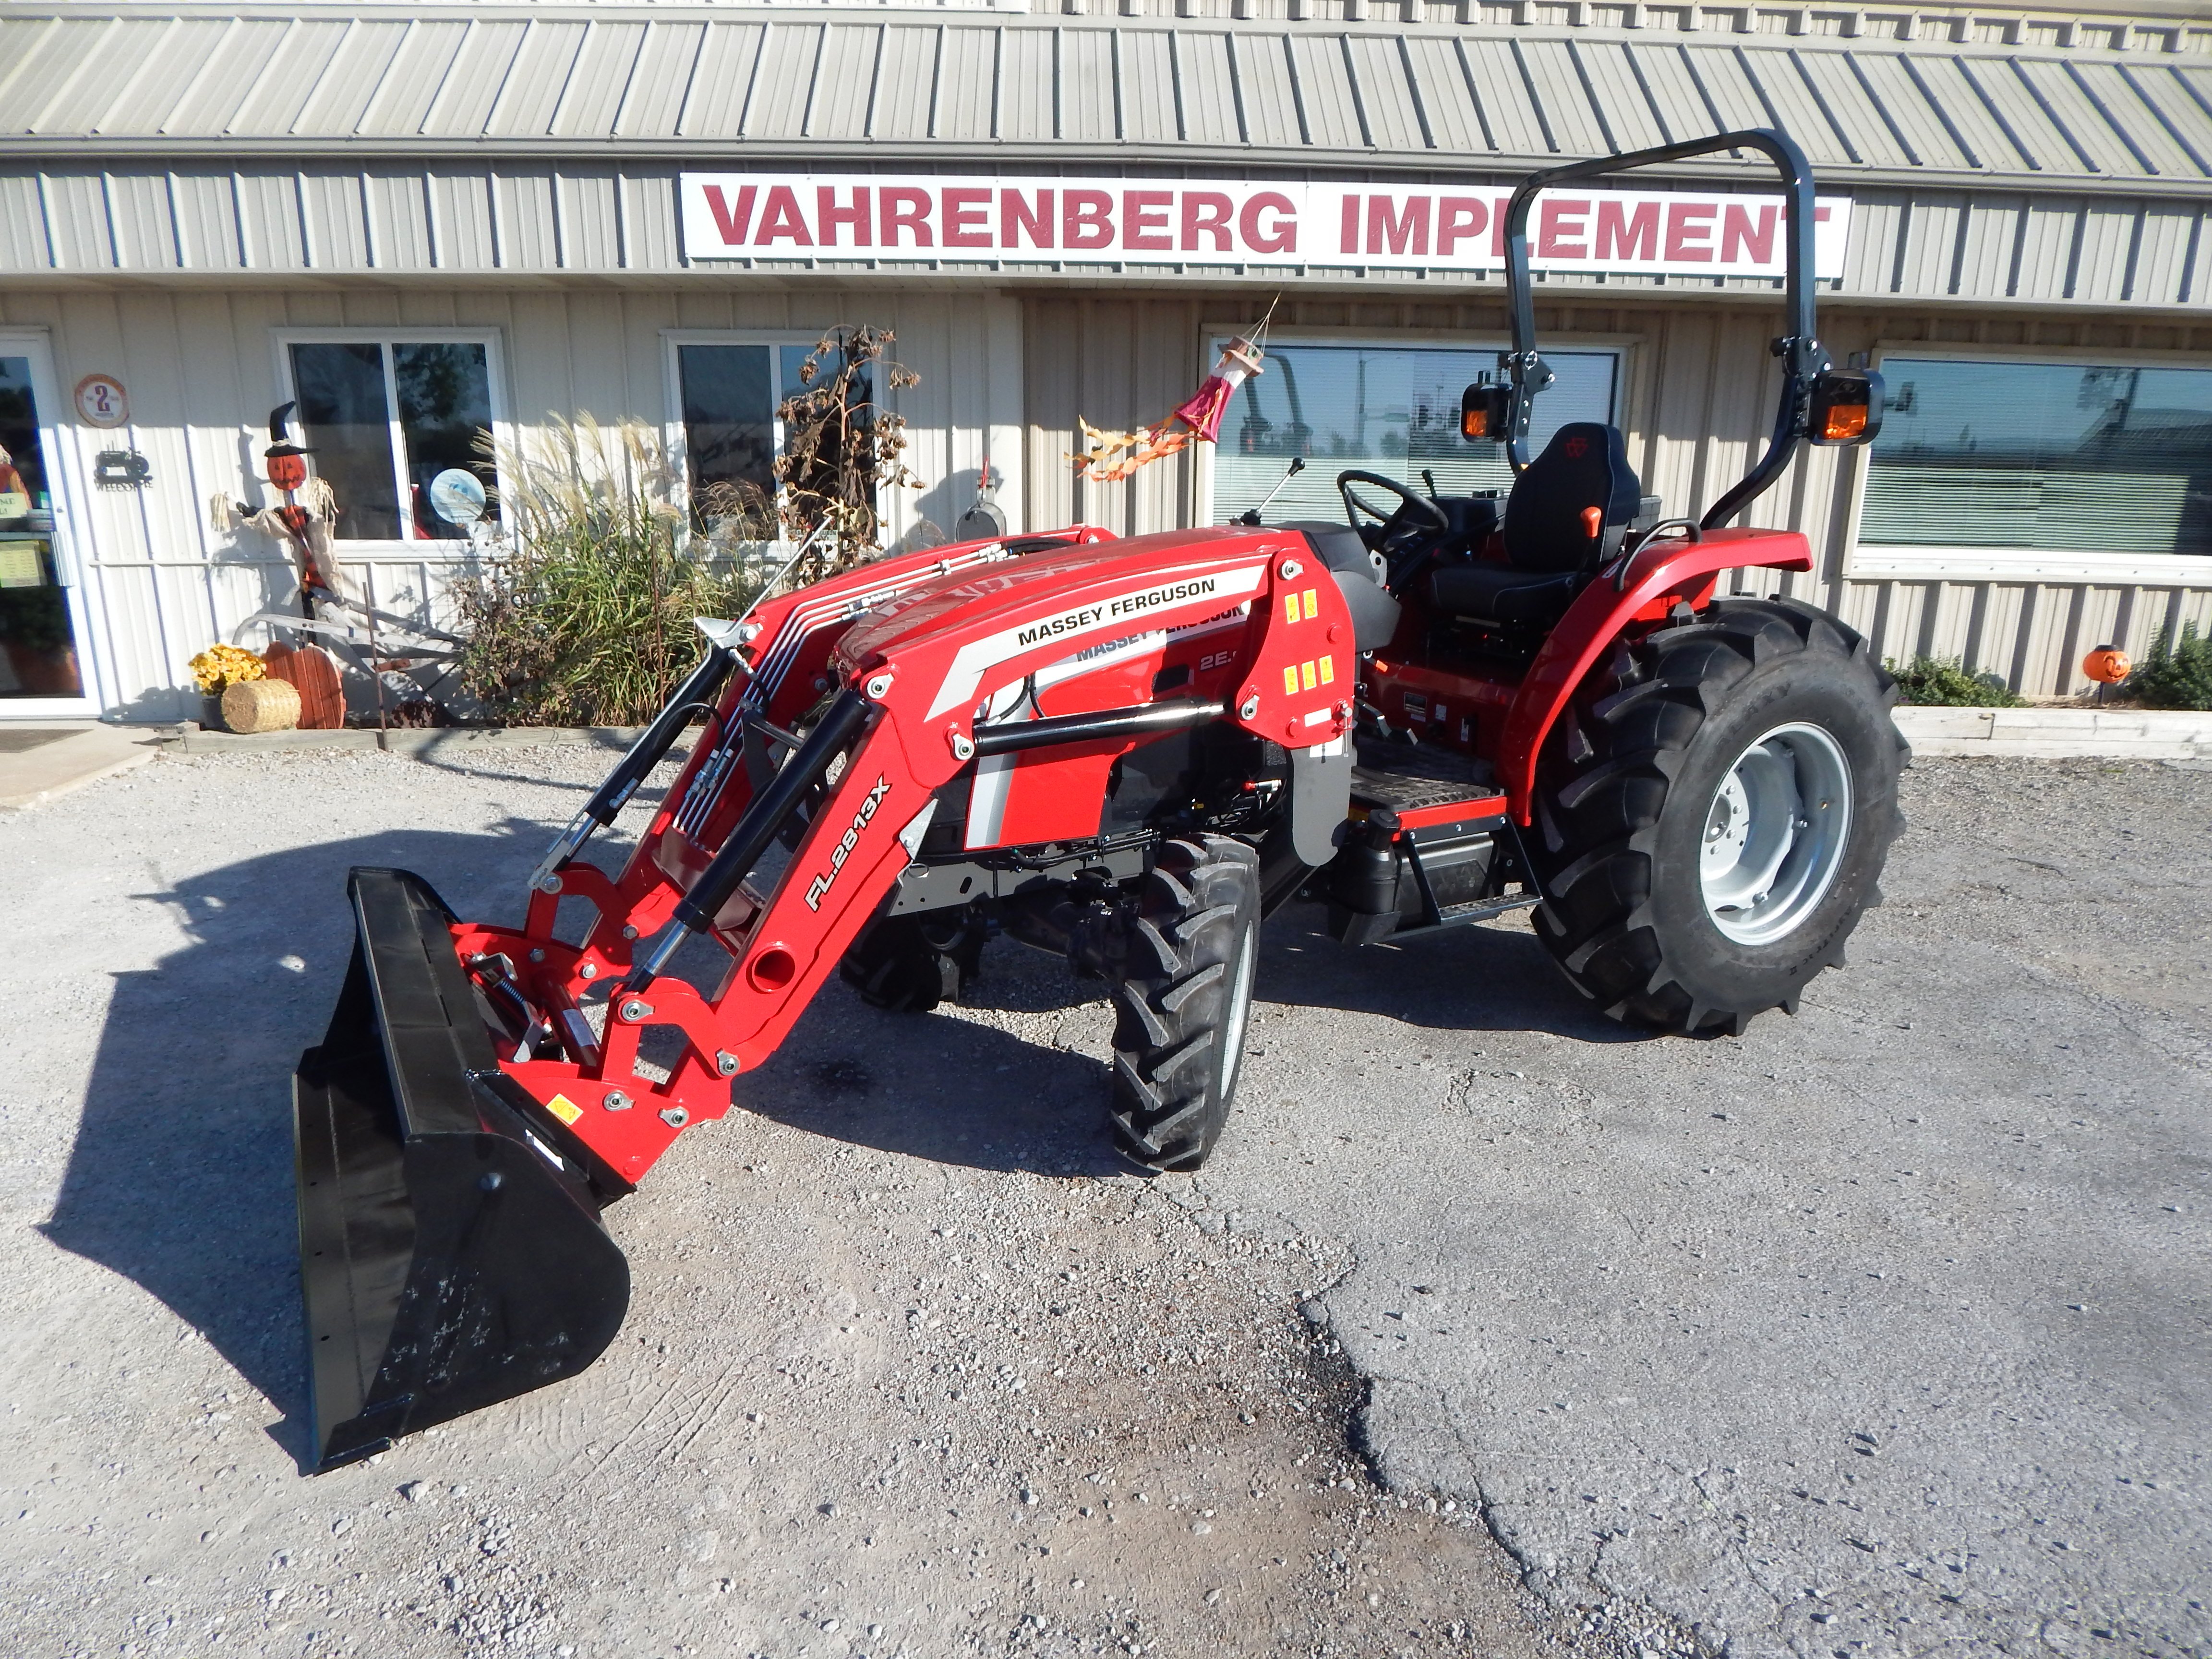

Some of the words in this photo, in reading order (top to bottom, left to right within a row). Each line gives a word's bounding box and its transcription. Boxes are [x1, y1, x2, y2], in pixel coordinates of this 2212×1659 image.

[703, 186, 1296, 253] VAHRENBERG
[94, 385, 110, 412] 2
[1018, 607, 1103, 646] MASSEY
[1111, 579, 1215, 616] FERGUSON
[1200, 650, 1237, 671] 2E.
[804, 771, 893, 914] FL.2813X
